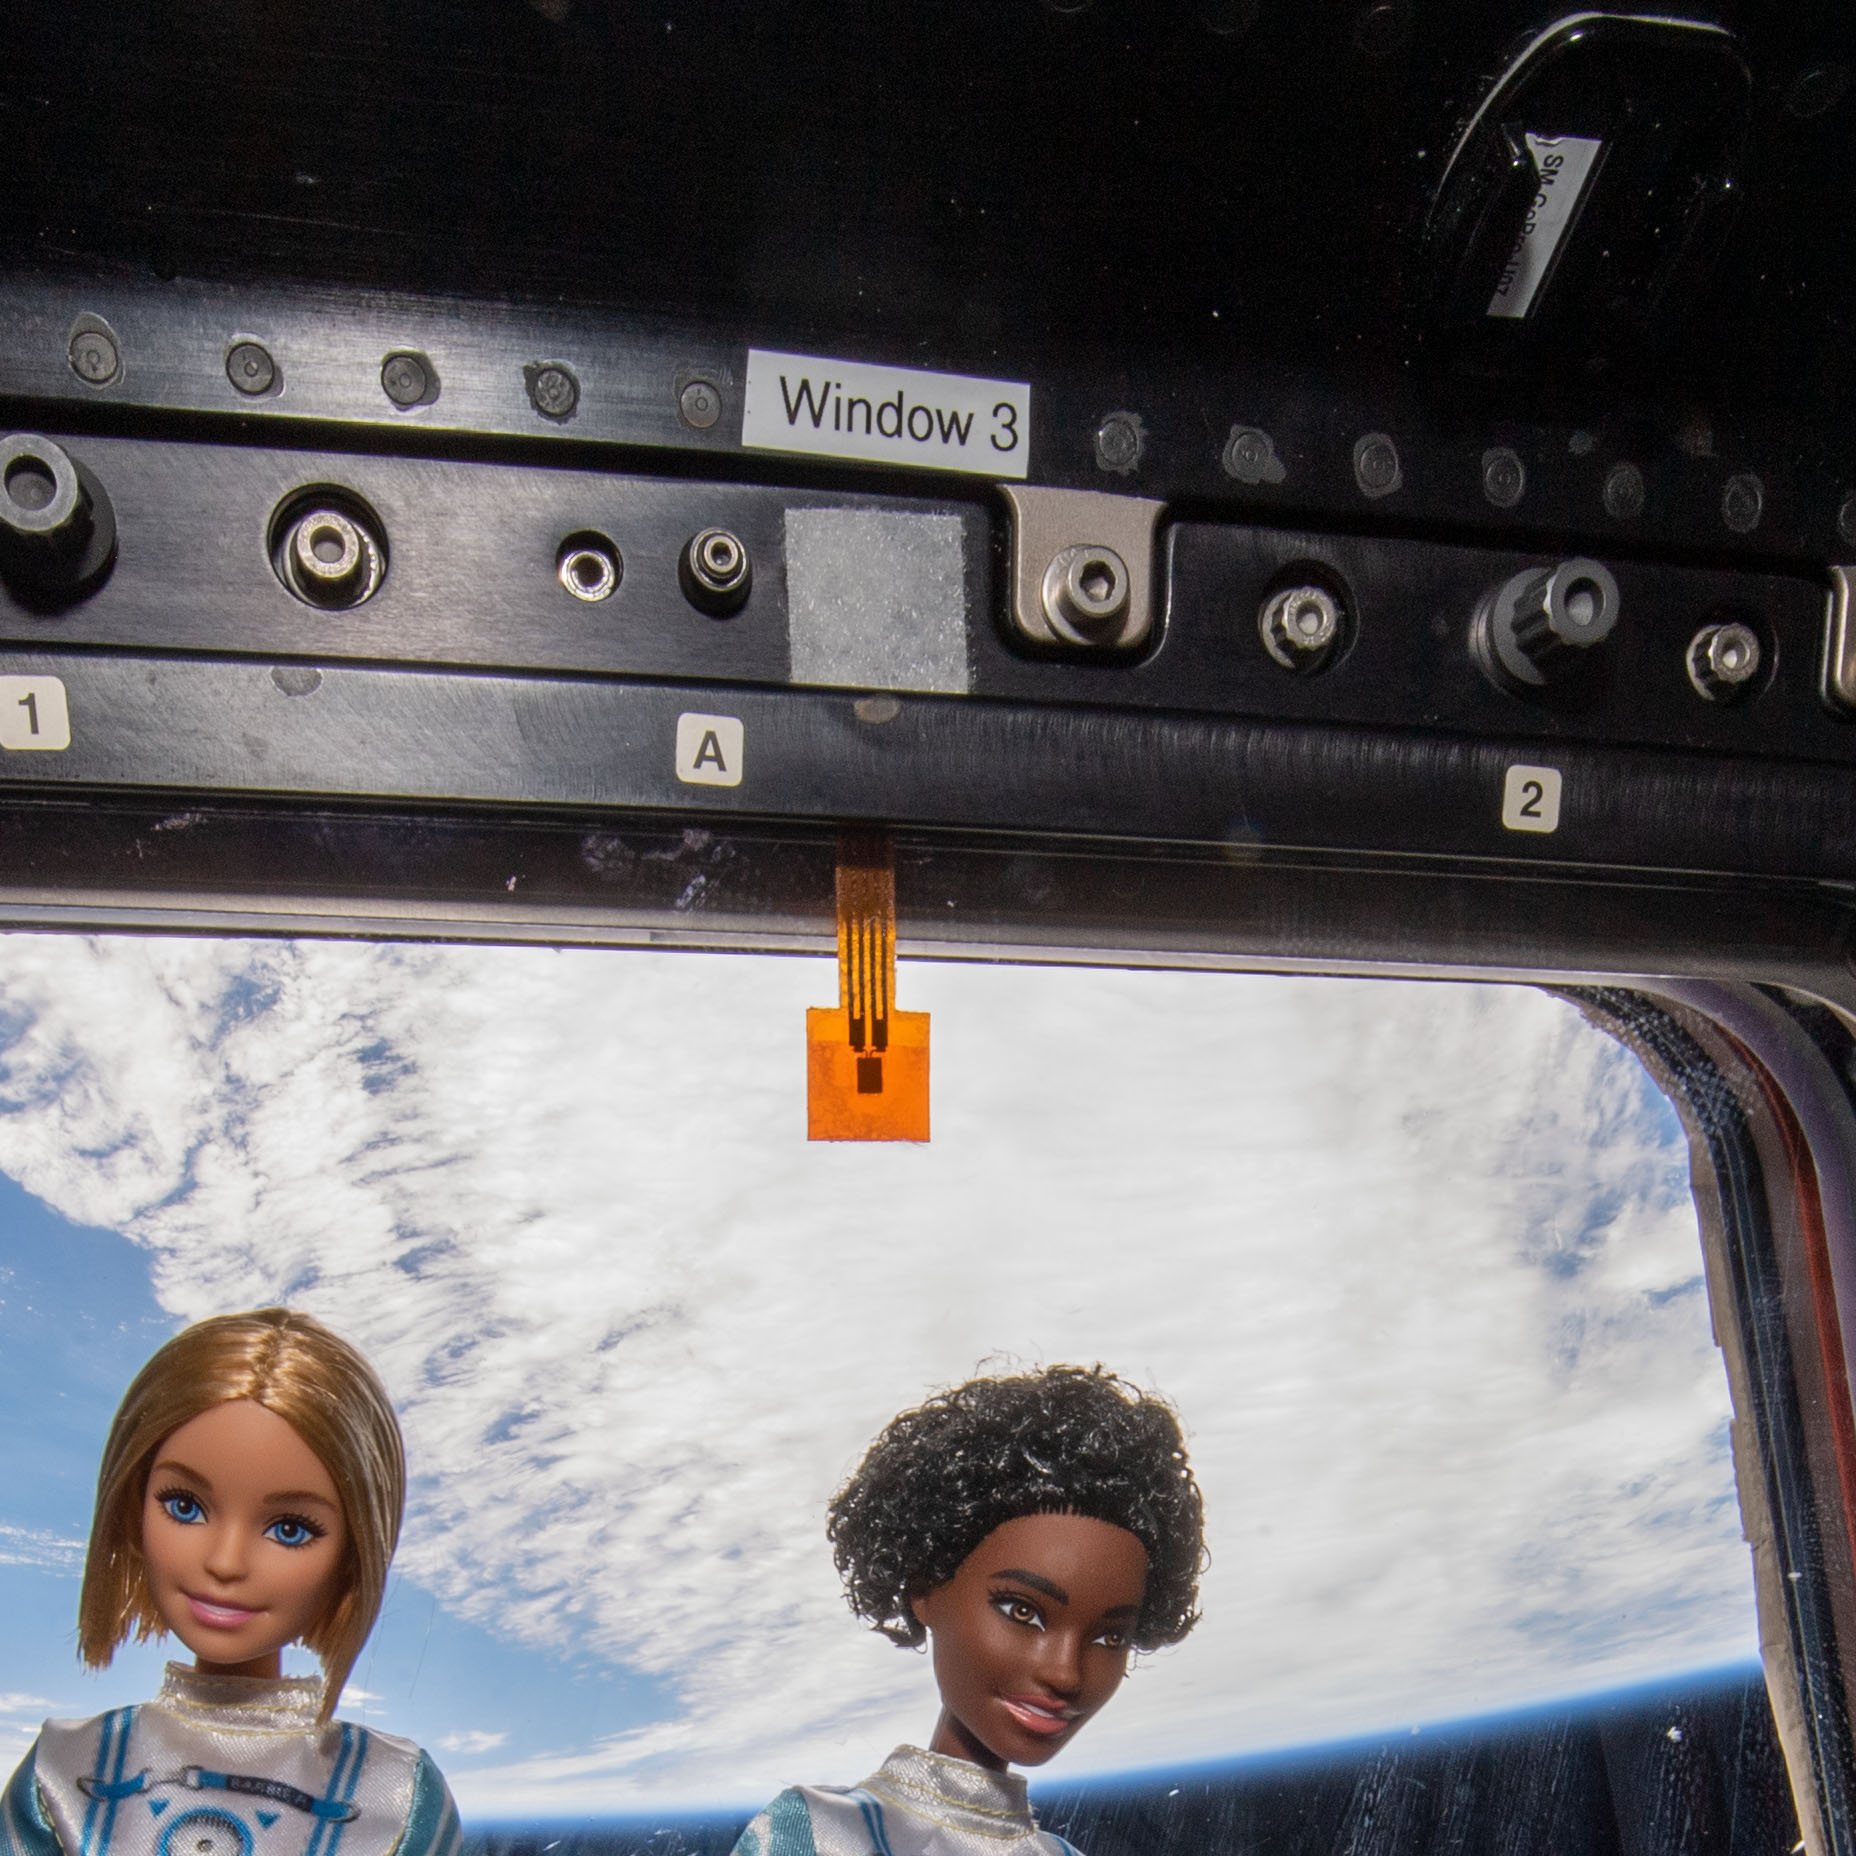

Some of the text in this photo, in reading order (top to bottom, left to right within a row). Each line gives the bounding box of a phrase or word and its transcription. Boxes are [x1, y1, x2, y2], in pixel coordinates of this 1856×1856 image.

[779, 376, 1019, 452] Window 3
[18, 692, 40, 735] 1
[692, 730, 727, 773] A
[1519, 780, 1544, 818] 2
